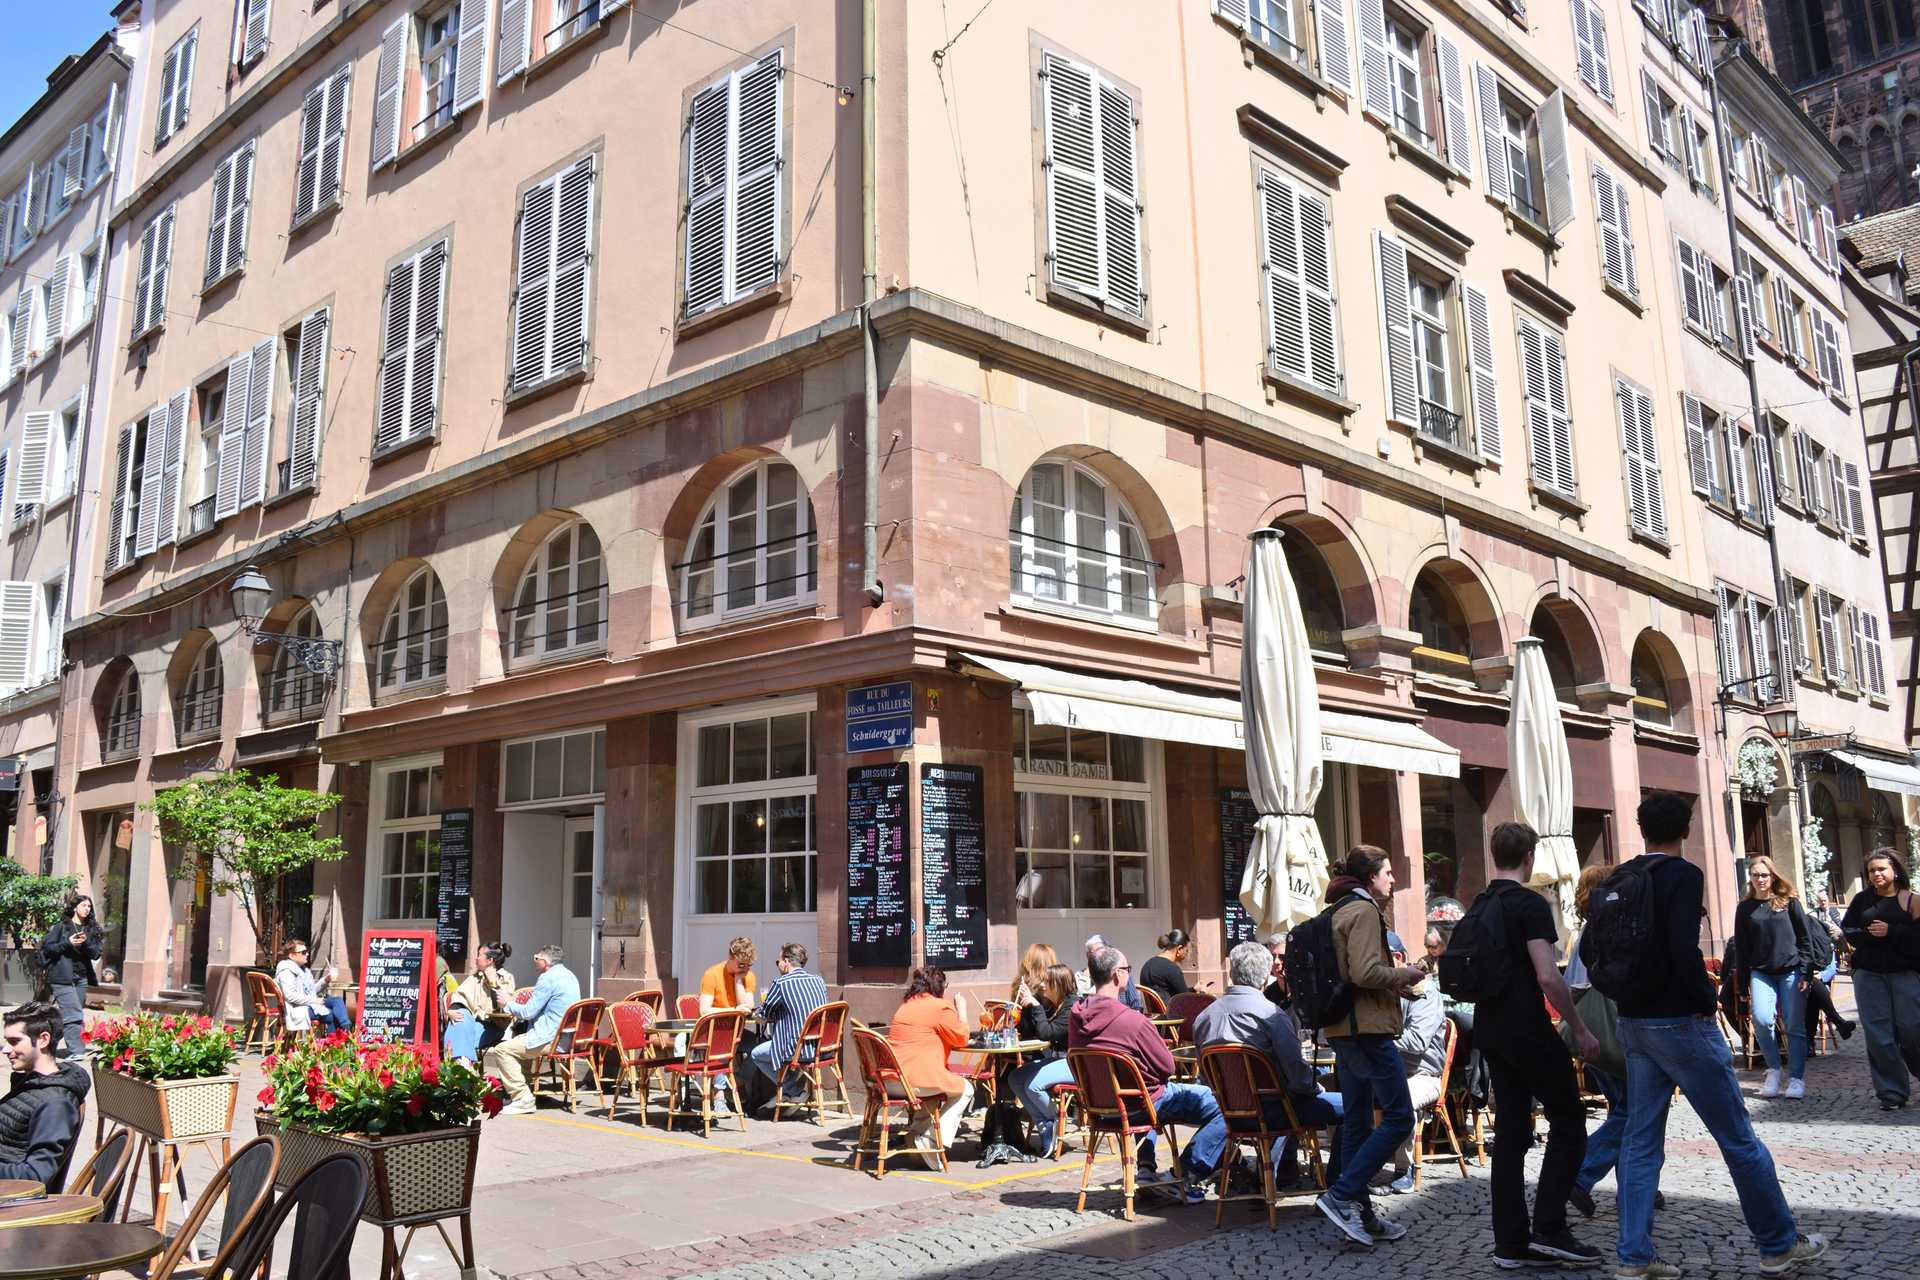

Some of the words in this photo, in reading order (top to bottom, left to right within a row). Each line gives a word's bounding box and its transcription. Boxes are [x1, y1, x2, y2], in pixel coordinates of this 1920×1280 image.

[866, 688, 879, 700] RUE
[880, 687, 890, 698] DU
[877, 698, 911, 712] TAILLEURS
[368, 958, 404, 968] HOMEMADE
[367, 966, 385, 976] FOOD
[366, 975, 380, 984] FAIT
[381, 975, 410, 984] MAISON
[365, 986, 379, 996] BAR
[363, 1009, 402, 1019] RESTAURANT
